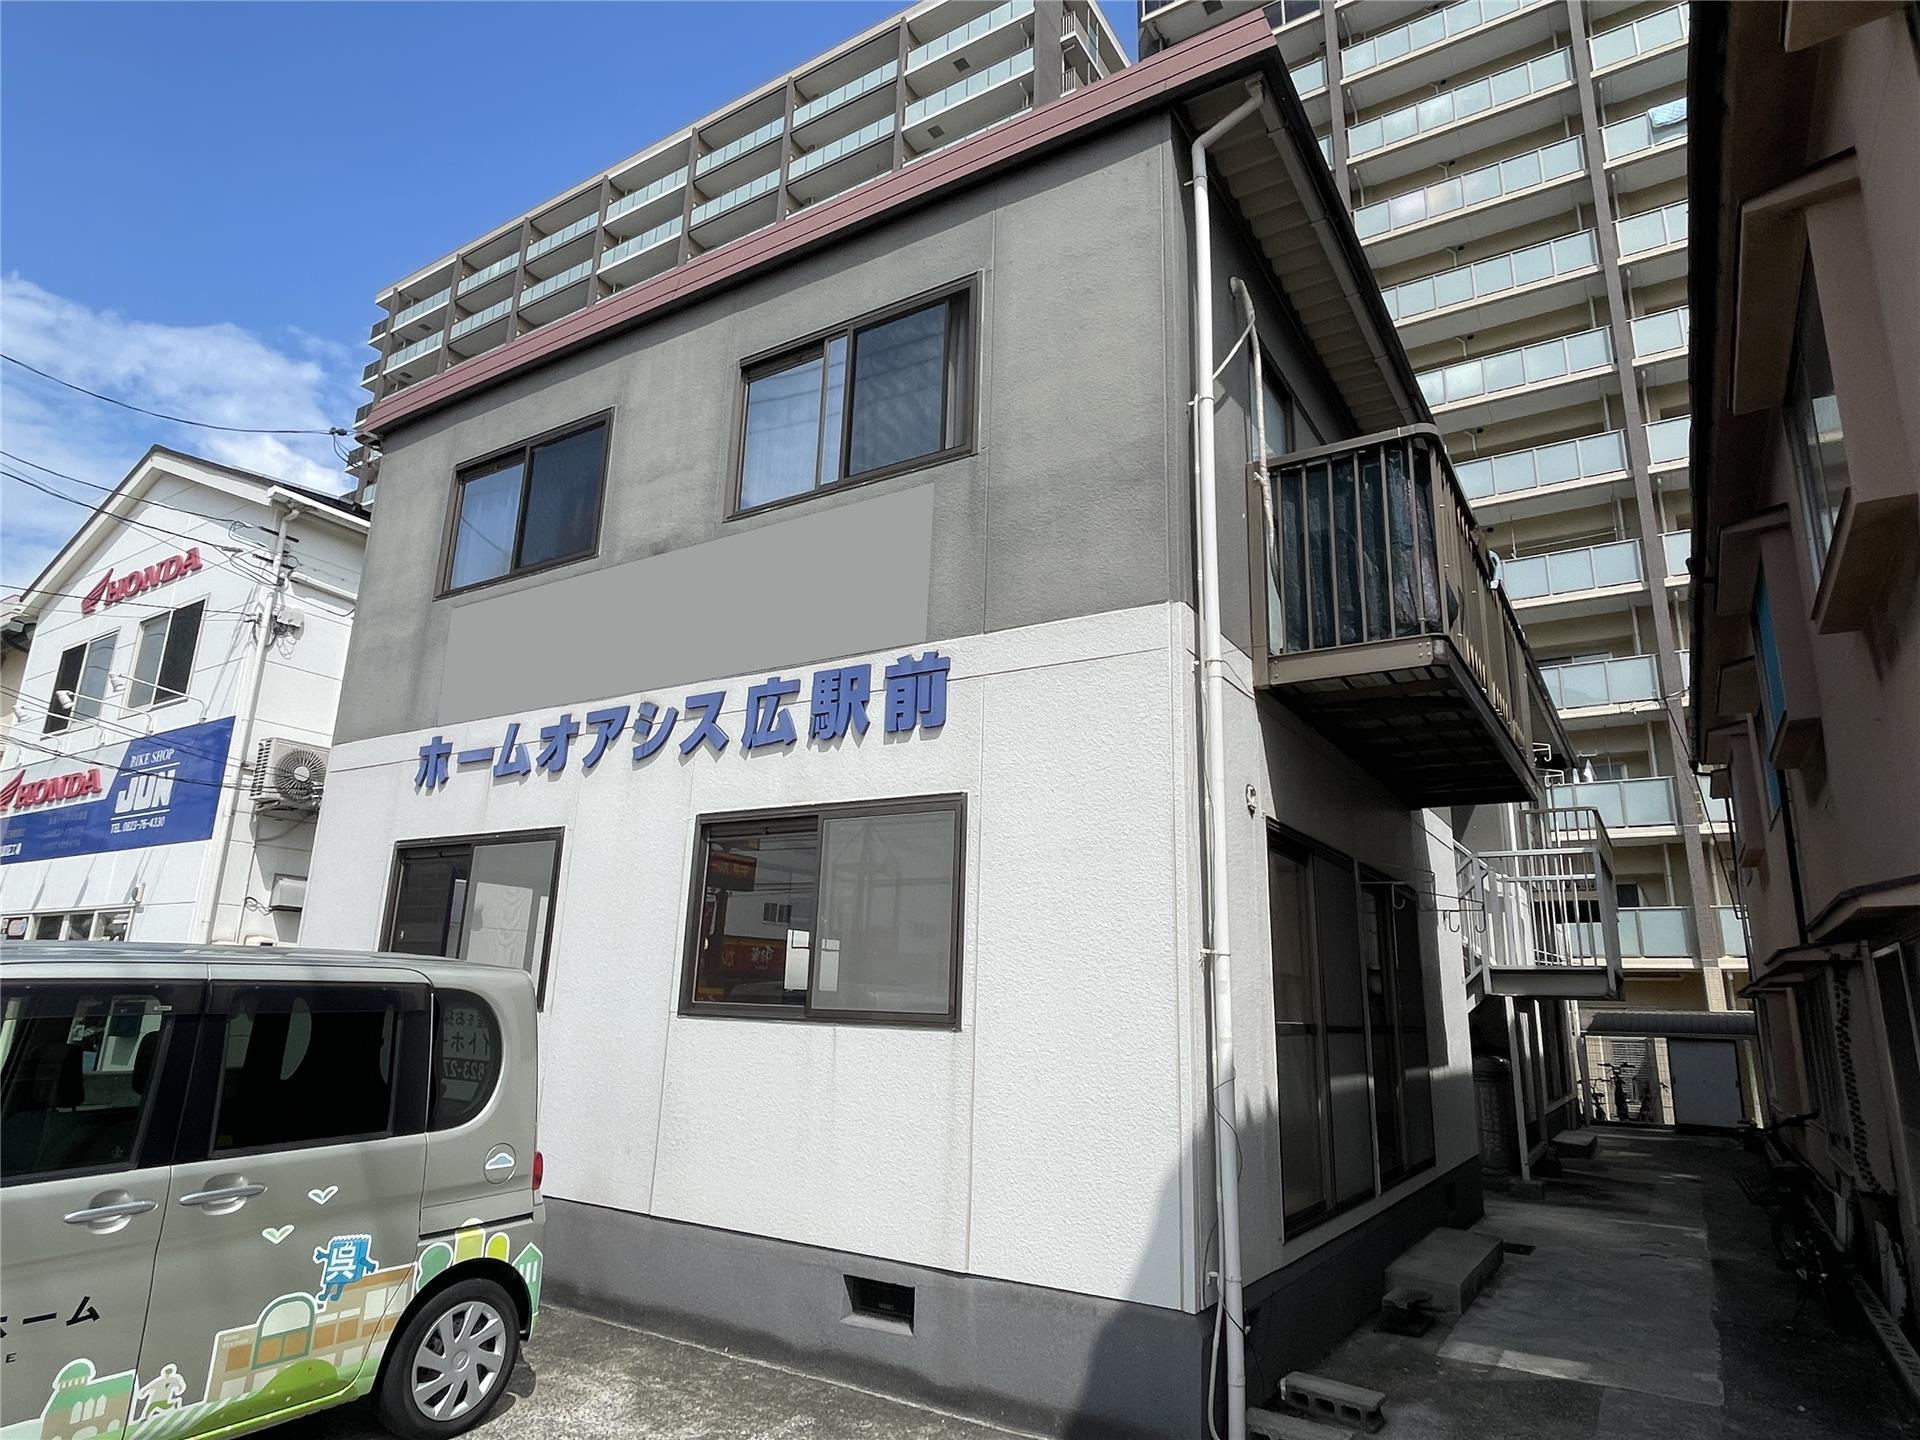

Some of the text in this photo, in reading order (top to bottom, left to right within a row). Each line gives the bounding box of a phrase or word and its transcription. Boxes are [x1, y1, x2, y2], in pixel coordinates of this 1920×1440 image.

[103, 547, 203, 606] HONDA
[414, 650, 950, 788] ホームオアシス広駅前
[130, 749, 176, 767] BIKE SHOP
[14, 768, 102, 809] HONDA
[114, 769, 176, 814] JUN
[0, 1296, 100, 1338] ーム
